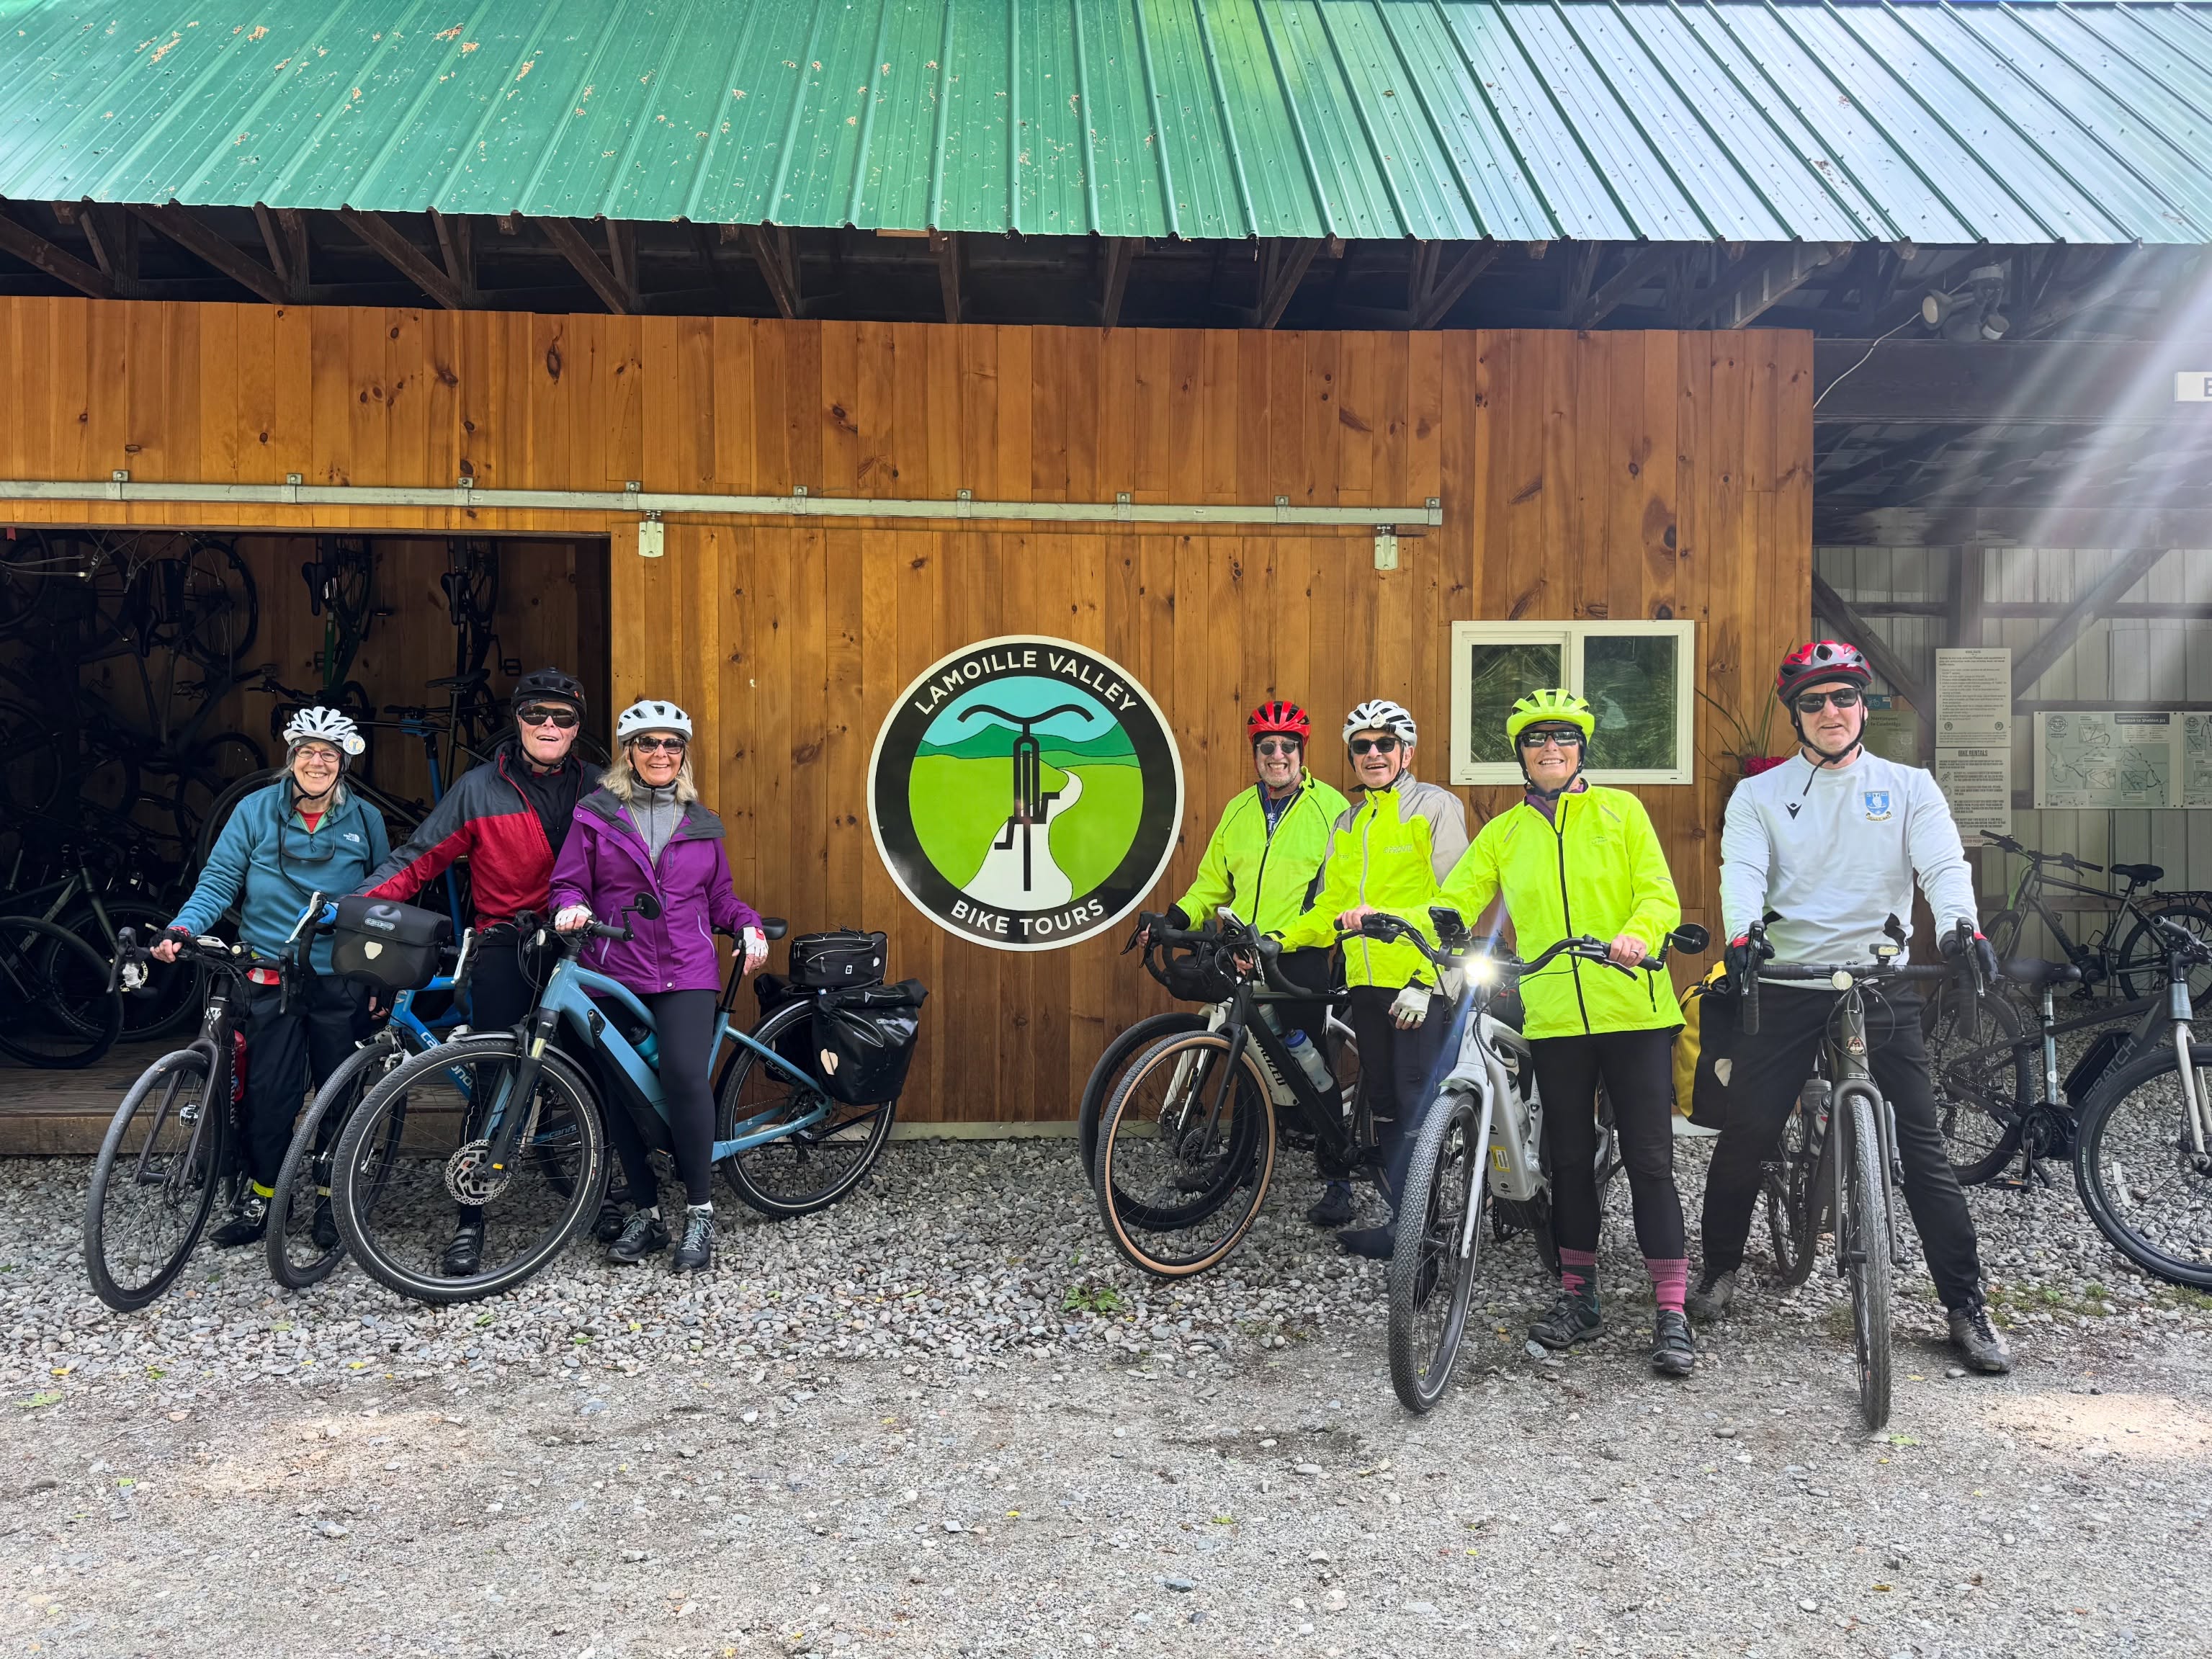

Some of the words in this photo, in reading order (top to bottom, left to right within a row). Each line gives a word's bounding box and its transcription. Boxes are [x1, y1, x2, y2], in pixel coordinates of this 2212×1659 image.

[915, 650, 1036, 715] LAMOILLE
[1049, 653, 1137, 712] VALLEY
[951, 900, 1010, 934] BIKE
[1019, 898, 1104, 936] TOURS
